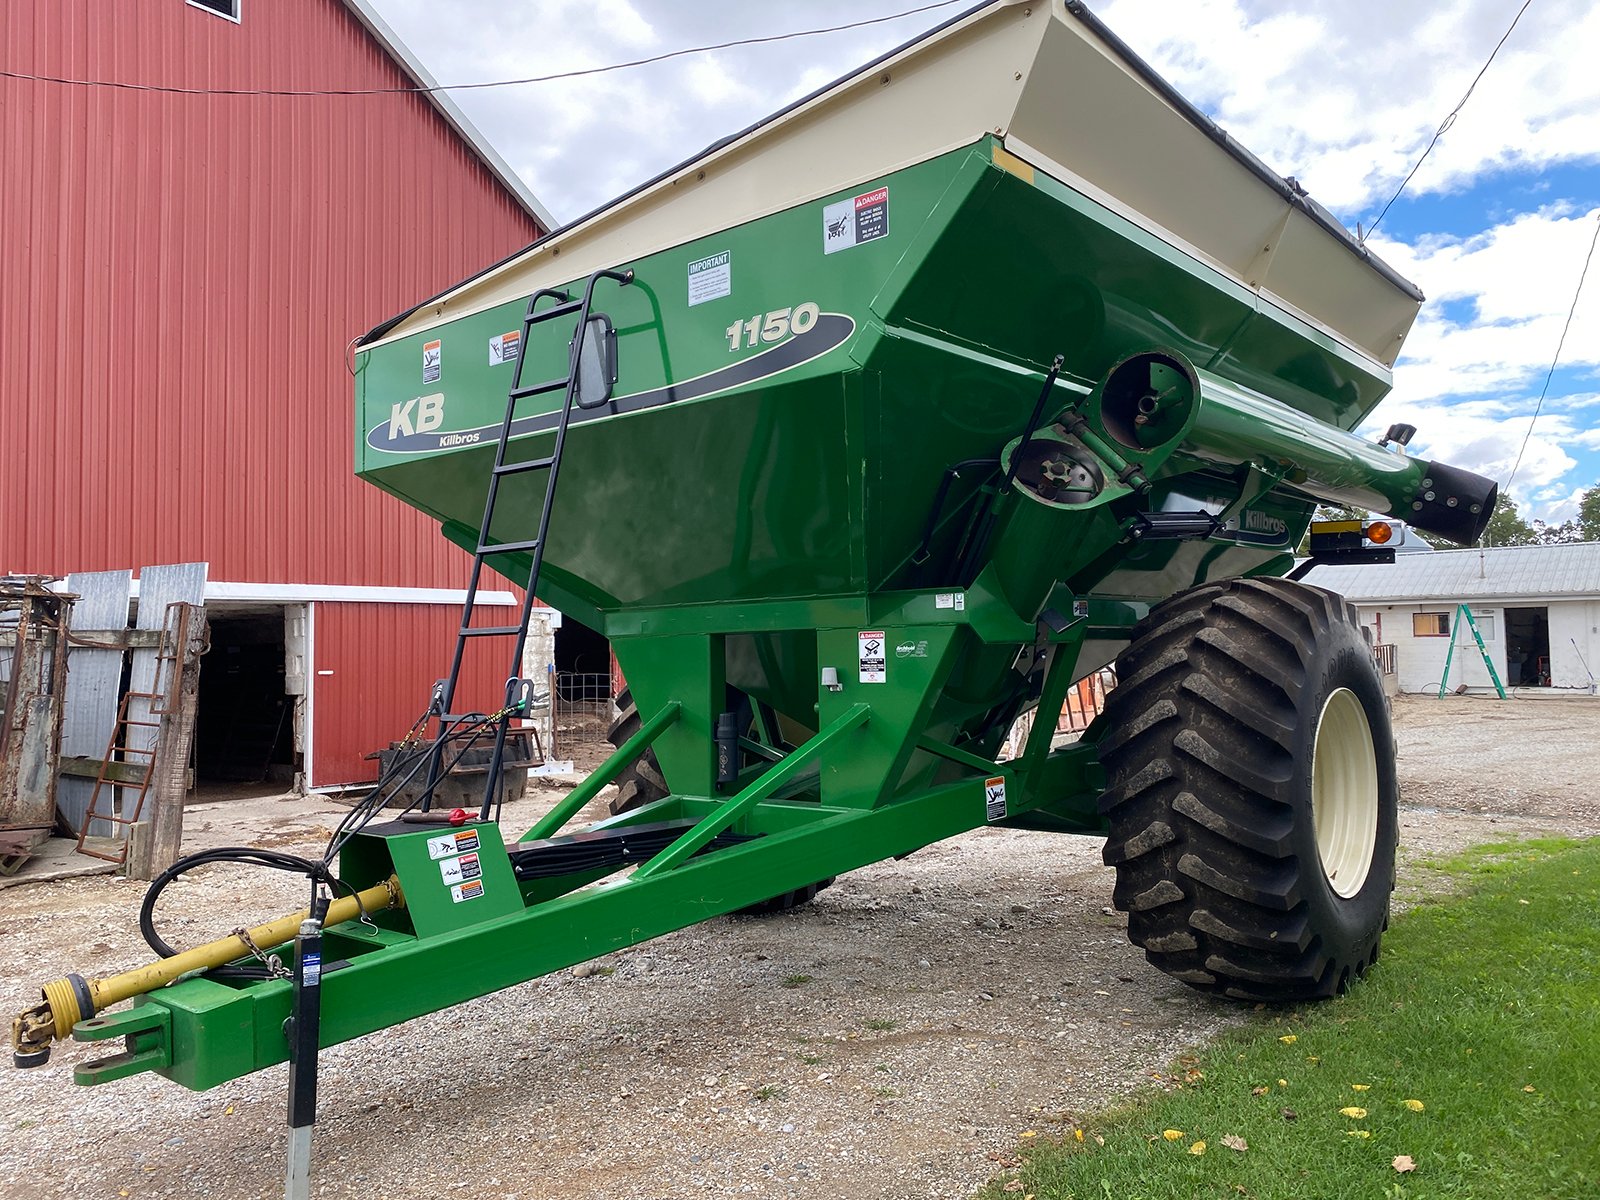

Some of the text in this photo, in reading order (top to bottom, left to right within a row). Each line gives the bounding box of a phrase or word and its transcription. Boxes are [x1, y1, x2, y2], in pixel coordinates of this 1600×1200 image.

[862, 191, 887, 205] DANGER
[690, 253, 728, 274] IMPORTANT
[725, 302, 820, 352] 1150
[388, 393, 445, 440] KB
[440, 432, 480, 447] Killbros
[1245, 510, 1286, 533] Killbros
